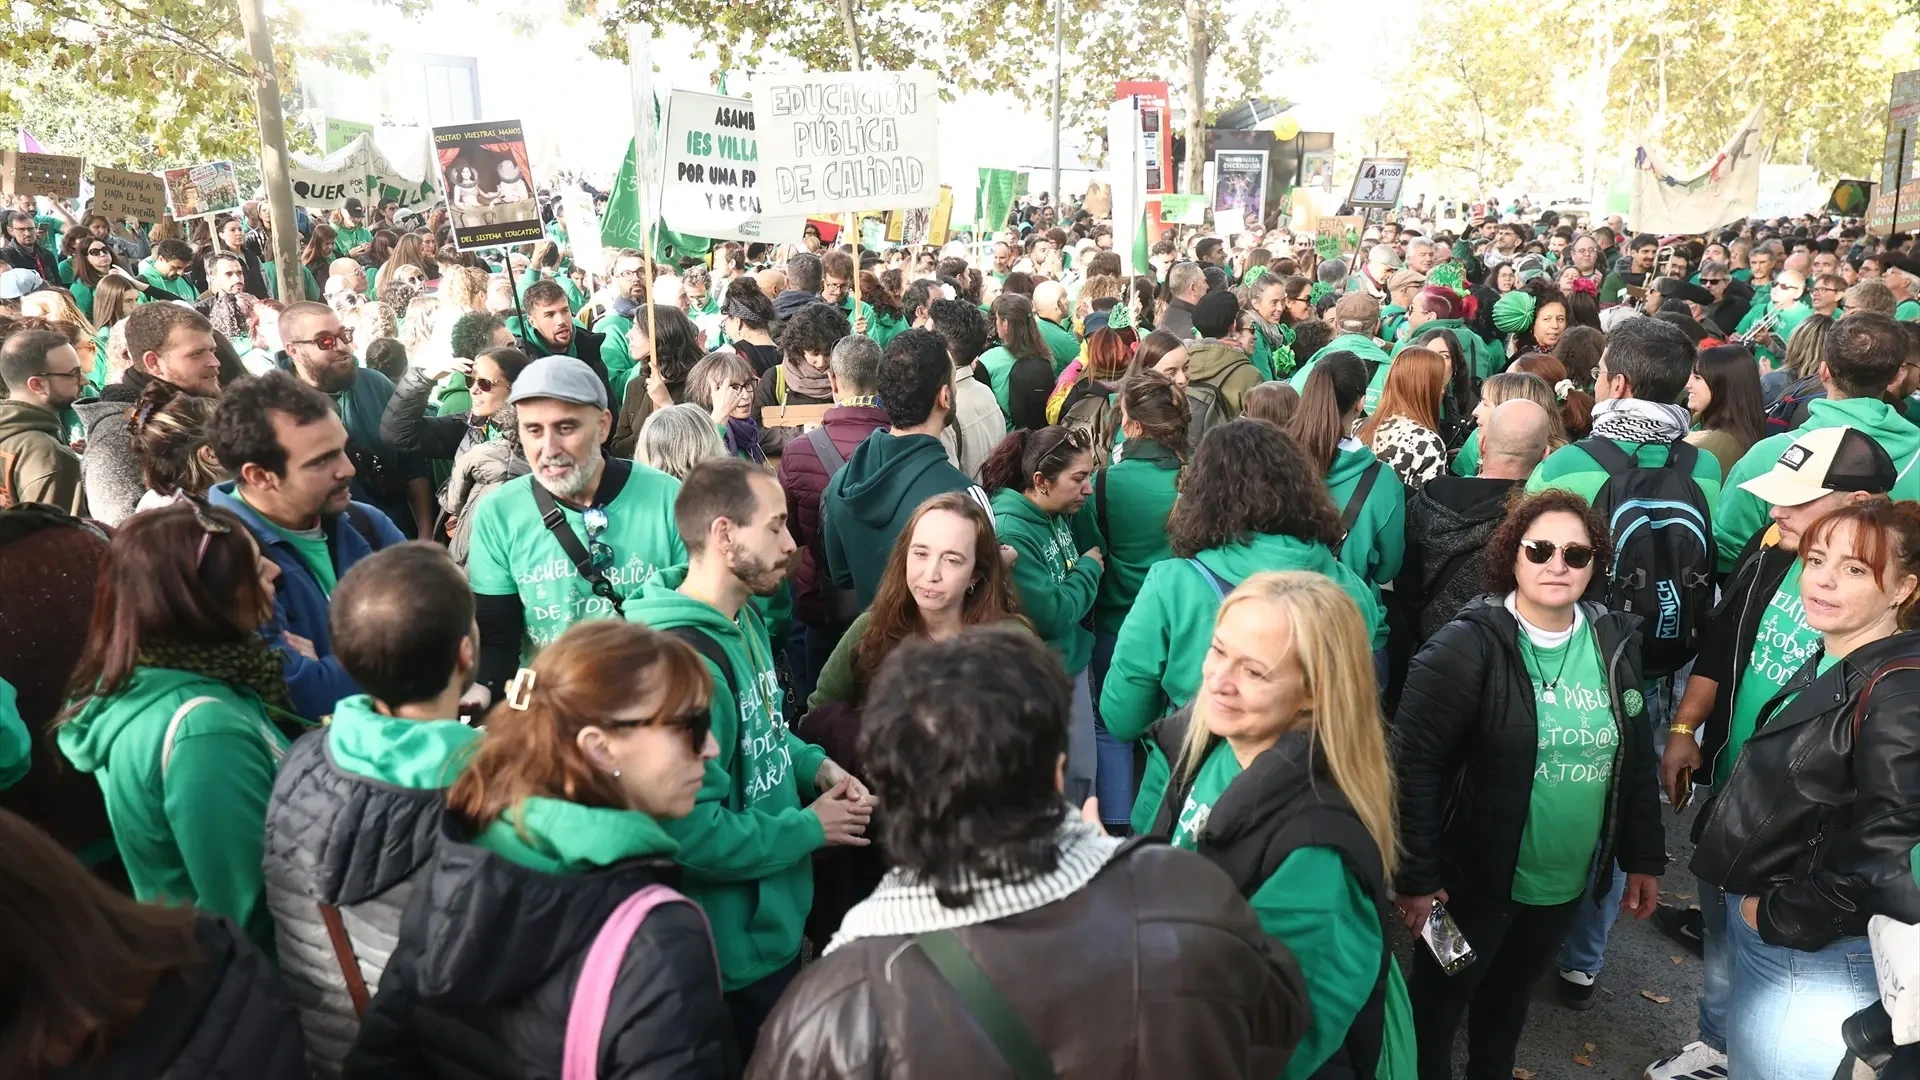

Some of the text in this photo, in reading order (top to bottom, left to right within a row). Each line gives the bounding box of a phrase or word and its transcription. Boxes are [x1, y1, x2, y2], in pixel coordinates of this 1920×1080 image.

[770, 74, 917, 116] EDUCACIÓN
[435, 127, 521, 143] QUITAD VUESTRAS MANOS
[687, 131, 711, 156] IES
[678, 162, 704, 183] POR
[709, 166, 737, 187] UNA
[1379, 168, 1400, 177] AYUSO
[350, 179, 363, 187] POR
[775, 165, 815, 203] DE
[126, 193, 135, 201] EL
[705, 192, 713, 209] Y
[719, 194, 734, 211] DE
[102, 201, 155, 219] SE REVIENTA
[1319, 219, 1344, 229] ESTA
[461, 227, 541, 244] DEL SISTEMA EDUCATIVO
[533, 603, 561, 620] DE
[1656, 581, 1677, 638] MUNICH
